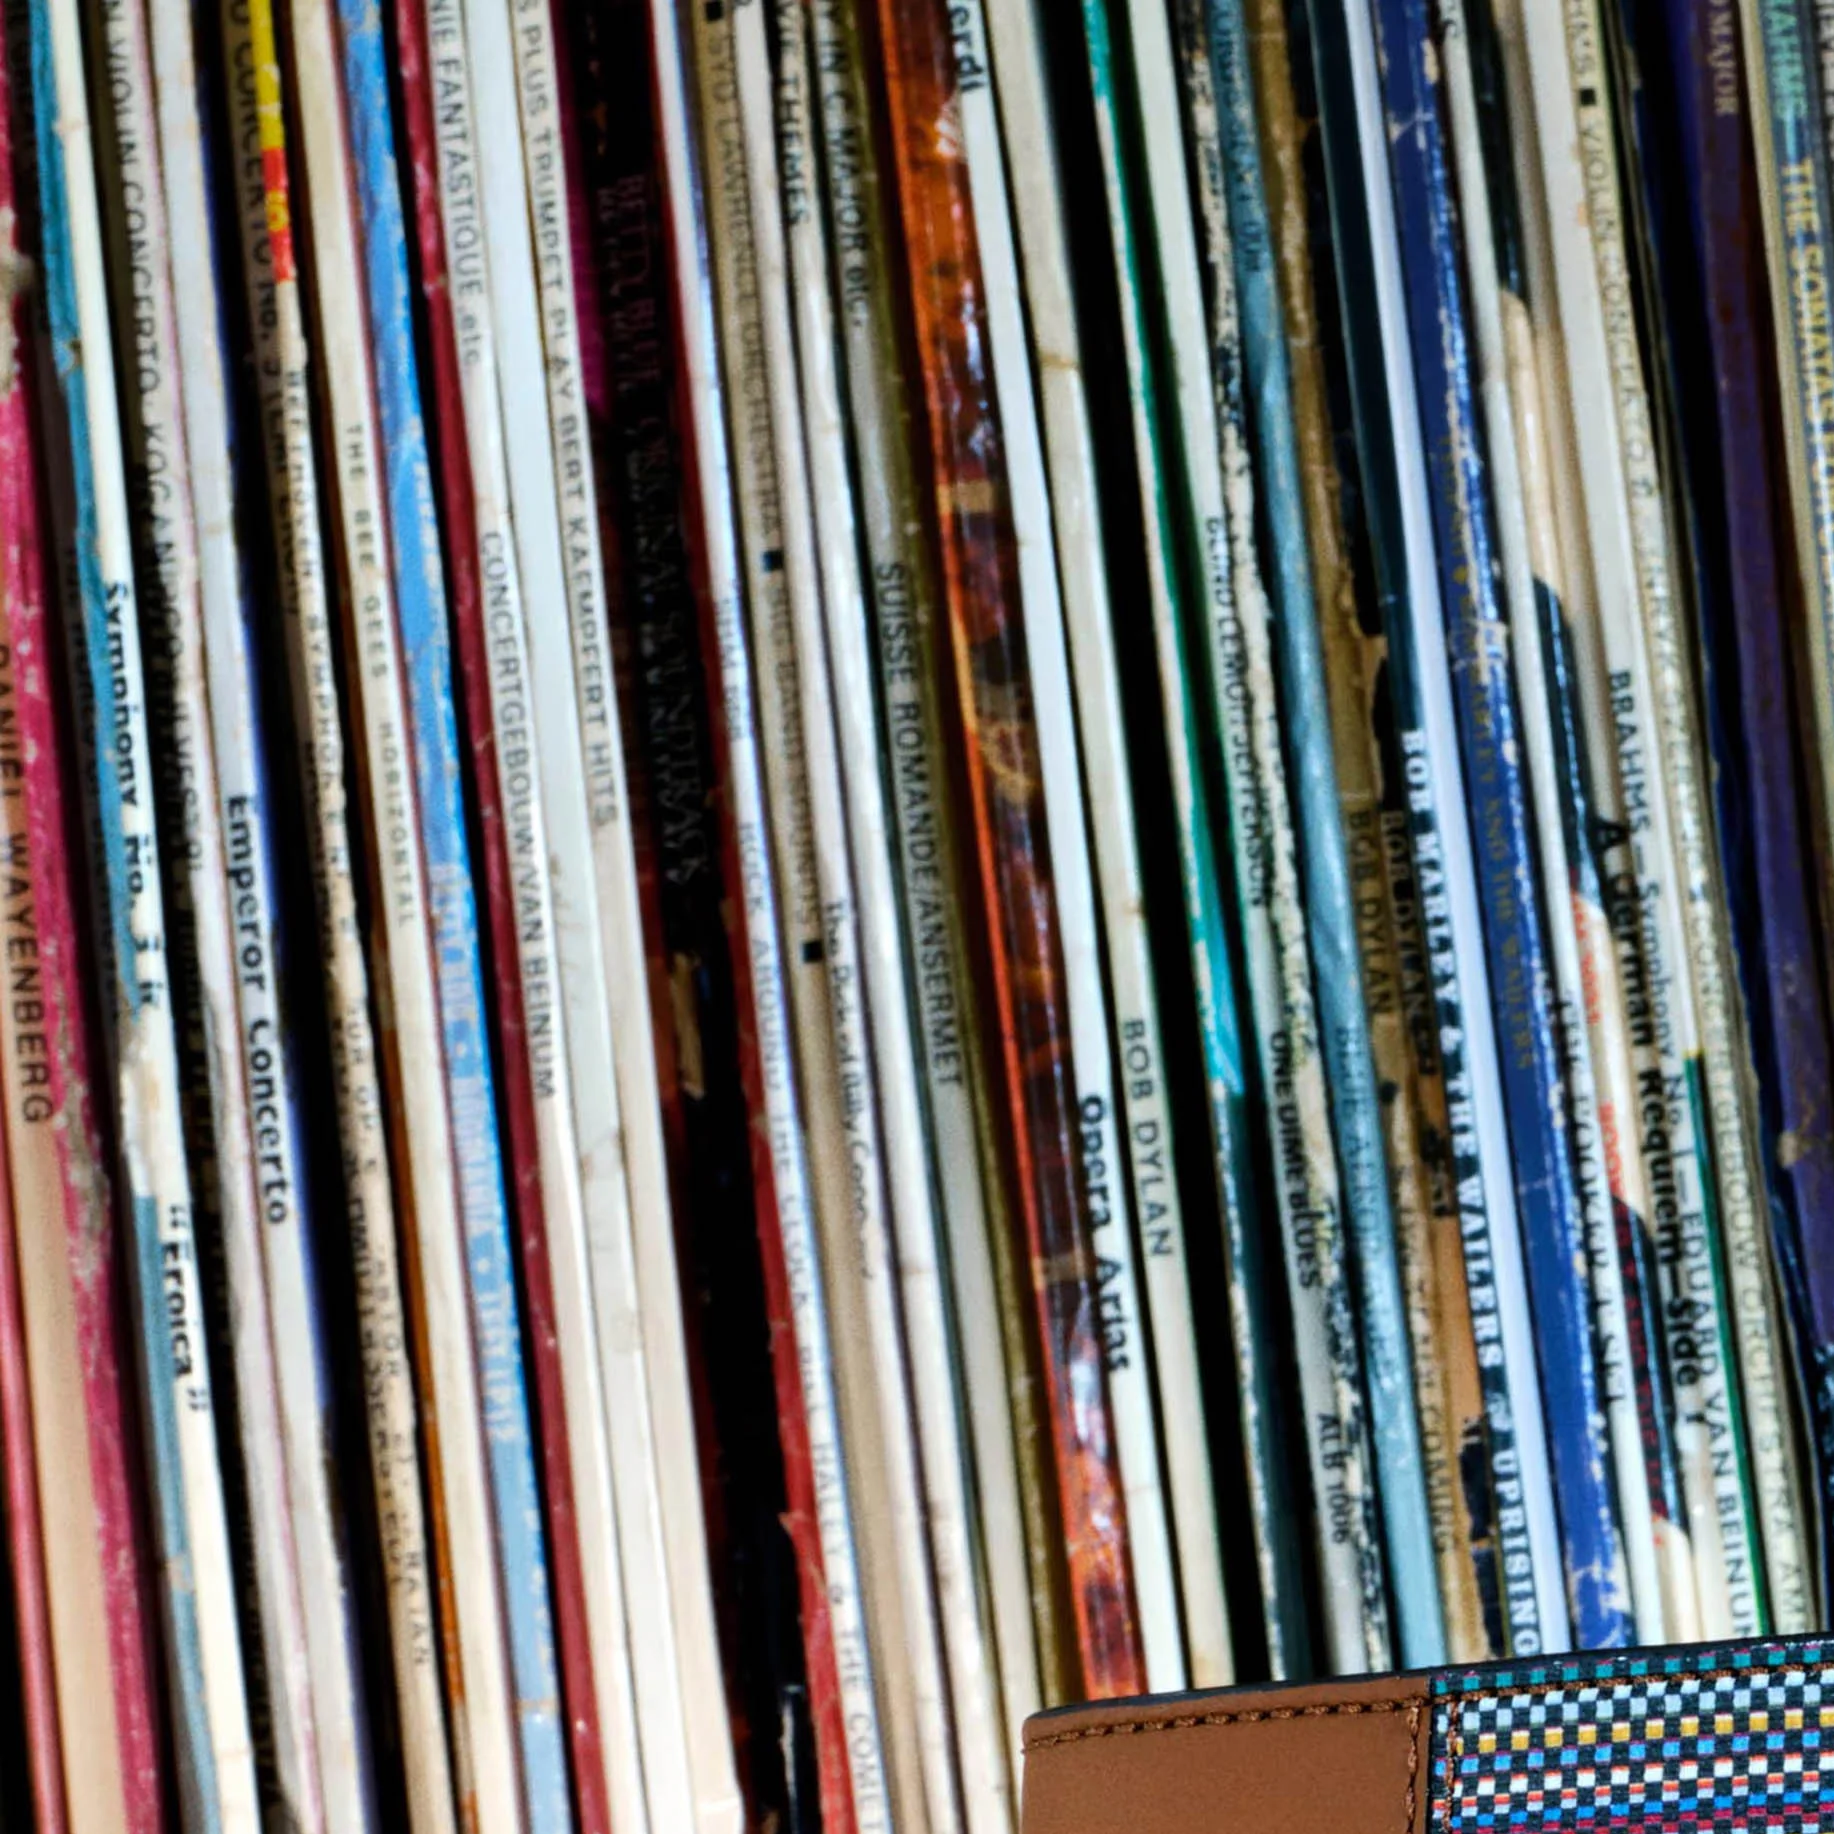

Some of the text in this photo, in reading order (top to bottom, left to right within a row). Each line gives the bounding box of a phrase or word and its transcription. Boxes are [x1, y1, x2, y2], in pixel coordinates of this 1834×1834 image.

[433, 57, 486, 299] FANTASTIQUE
[1703, 12, 1738, 117] MAJOR
[828, 127, 868, 255] MAJOR
[1777, 156, 1820, 239] THE
[514, 24, 619, 829] PLUS TRUMPET BERT KAEMPFERT HITS
[871, 560, 916, 686] SUISSE
[1, 832, 54, 1125] WAYENBERG
[220, 793, 295, 1226] Emperor Concerto
[519, 955, 562, 1102] BEINUM
[1603, 870, 1656, 1048] German
[1605, 670, 1649, 835] BRAHMS
[1676, 1210, 1719, 1376] EDUARD
[1699, 1389, 1731, 1466] VAN
[1074, 1093, 1134, 1374] Opera Arias
[1120, 1017, 1173, 1260] BOB DYLAN
[1399, 726, 1541, 1659] BOB MARLEY & THE WAILERS UPRISING
[813, 1441, 852, 1561] HALEY
[836, 1626, 869, 1693] THE
